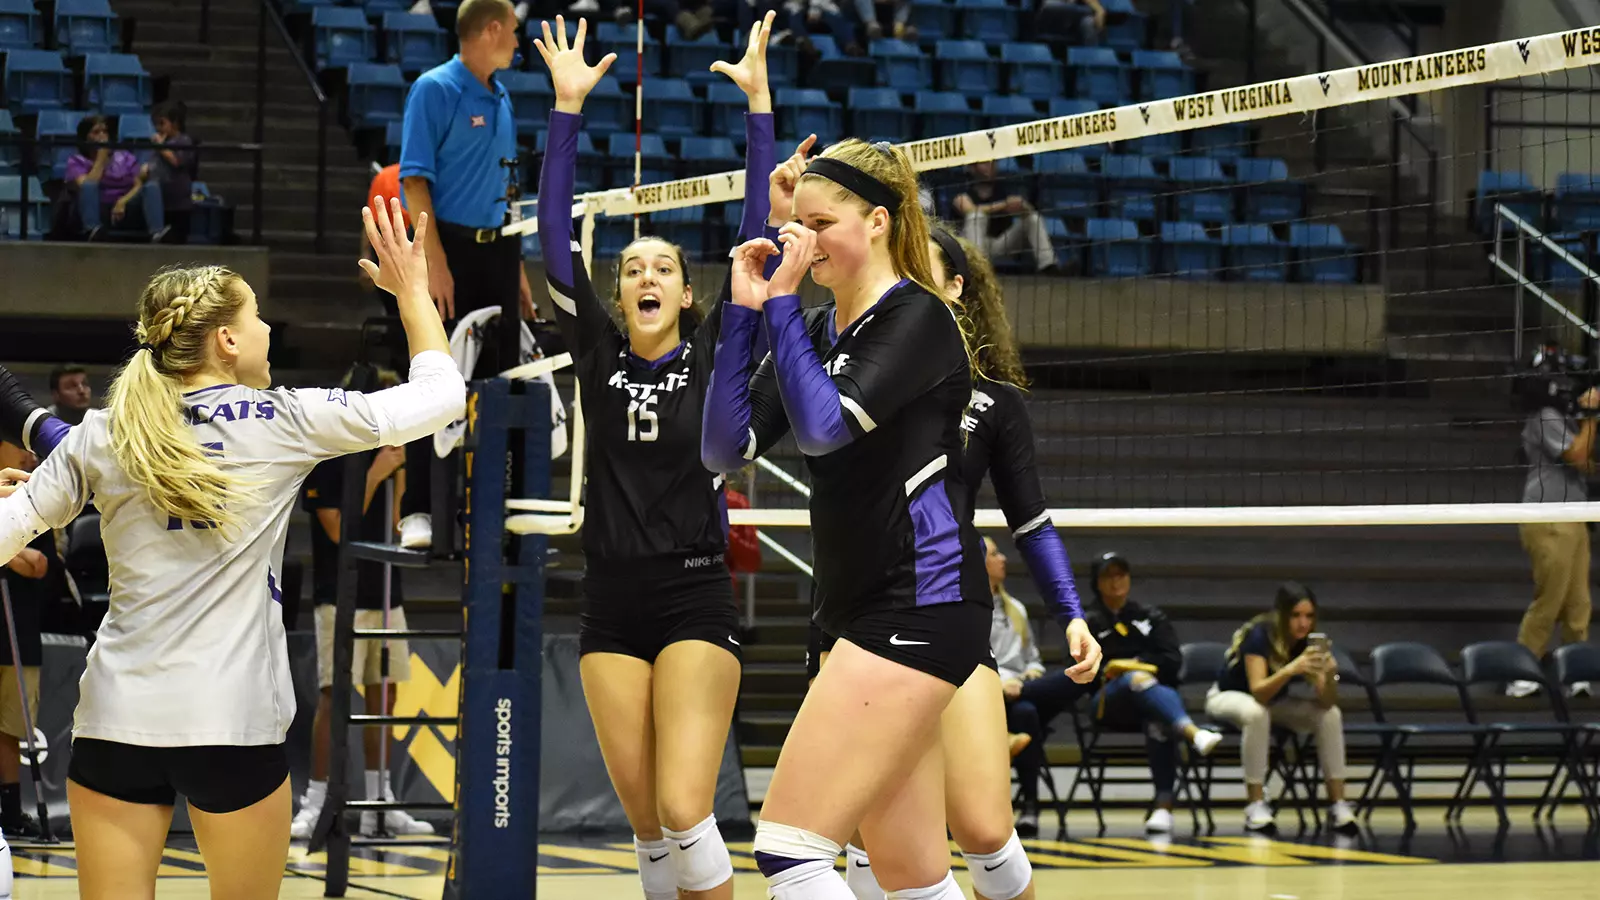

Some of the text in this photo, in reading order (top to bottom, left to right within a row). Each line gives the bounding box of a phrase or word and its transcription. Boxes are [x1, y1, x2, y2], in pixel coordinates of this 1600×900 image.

[910, 136, 966, 163] VIRGINIA
[1017, 111, 1116, 147] MOUNTAINEERS
[1173, 94, 1214, 121] WEST
[1221, 82, 1293, 114] VIRGINIA
[1358, 48, 1486, 91] MOUNTAINEERS
[635, 186, 662, 205] WEST
[666, 179, 710, 201] VIRGINIA
[627, 394, 659, 442] 15
[684, 556, 711, 568] NIKE
[492, 698, 513, 828] sports imports
